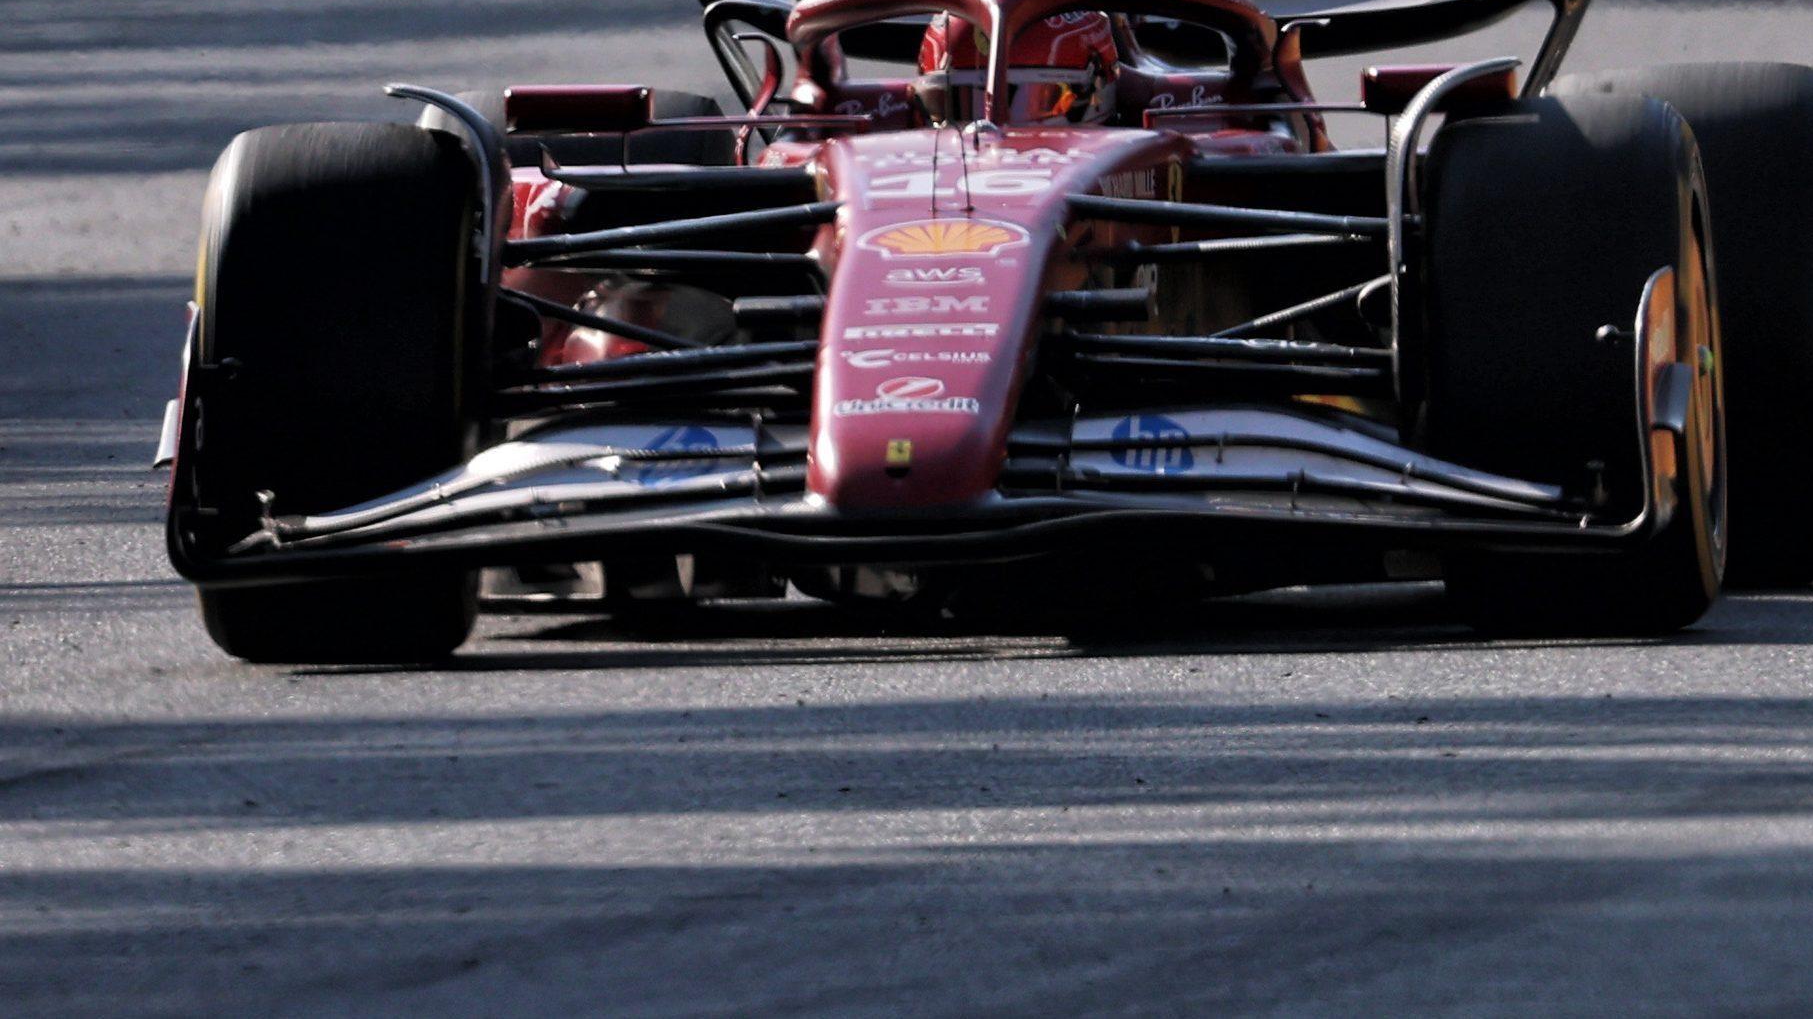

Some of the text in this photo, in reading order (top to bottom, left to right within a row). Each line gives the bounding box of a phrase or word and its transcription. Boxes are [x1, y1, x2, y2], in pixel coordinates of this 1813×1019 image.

[866, 168, 1053, 199] 16
[886, 267, 985, 284] aws
[864, 295, 991, 316] IBM
